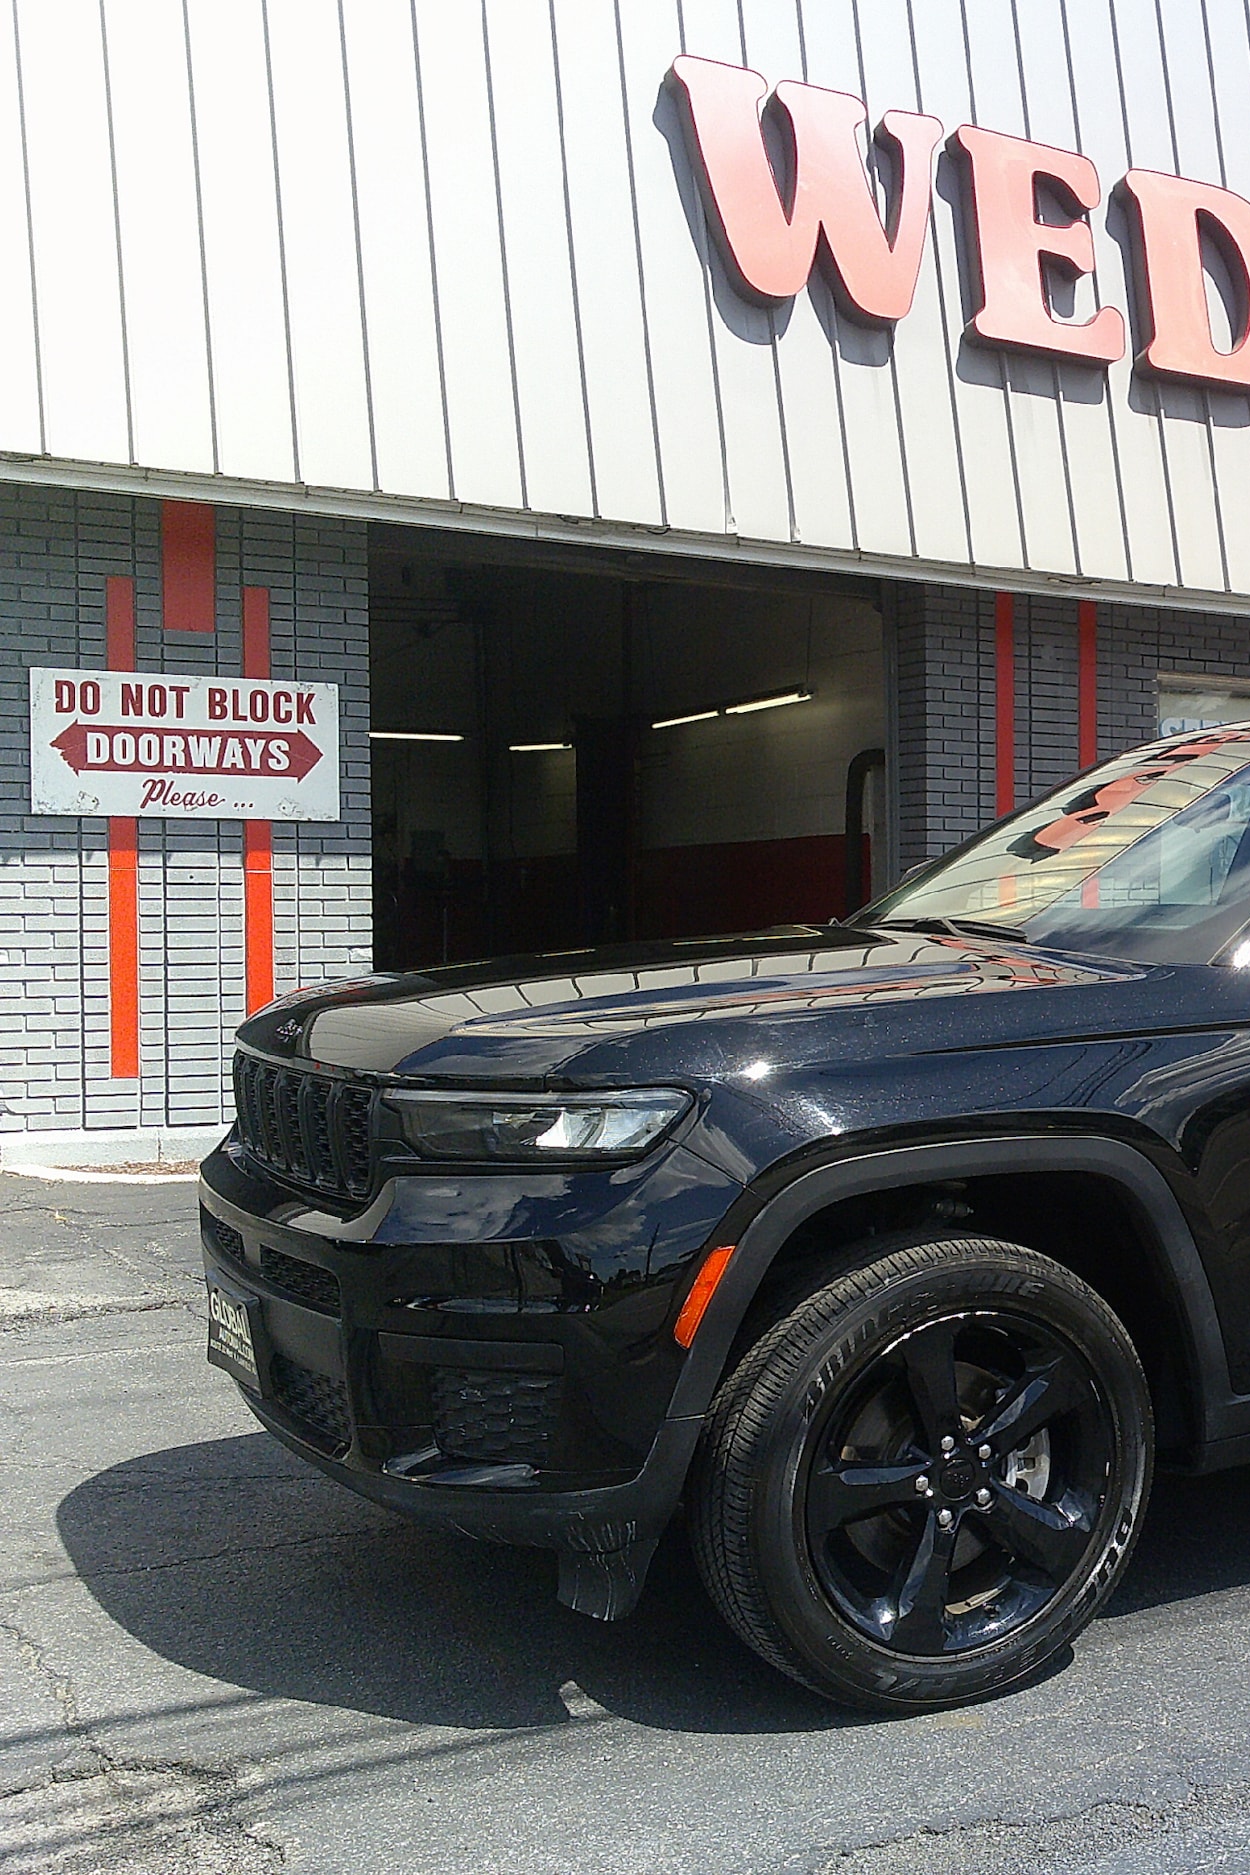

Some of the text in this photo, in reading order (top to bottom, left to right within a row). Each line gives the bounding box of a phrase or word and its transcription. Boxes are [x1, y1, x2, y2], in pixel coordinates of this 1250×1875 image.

[54, 679, 317, 725] DO NOT BLOCK
[86, 731, 290, 771] DOORWAYS
[140, 778, 225, 809] Please
[210, 1291, 252, 1345] GLOBAL
